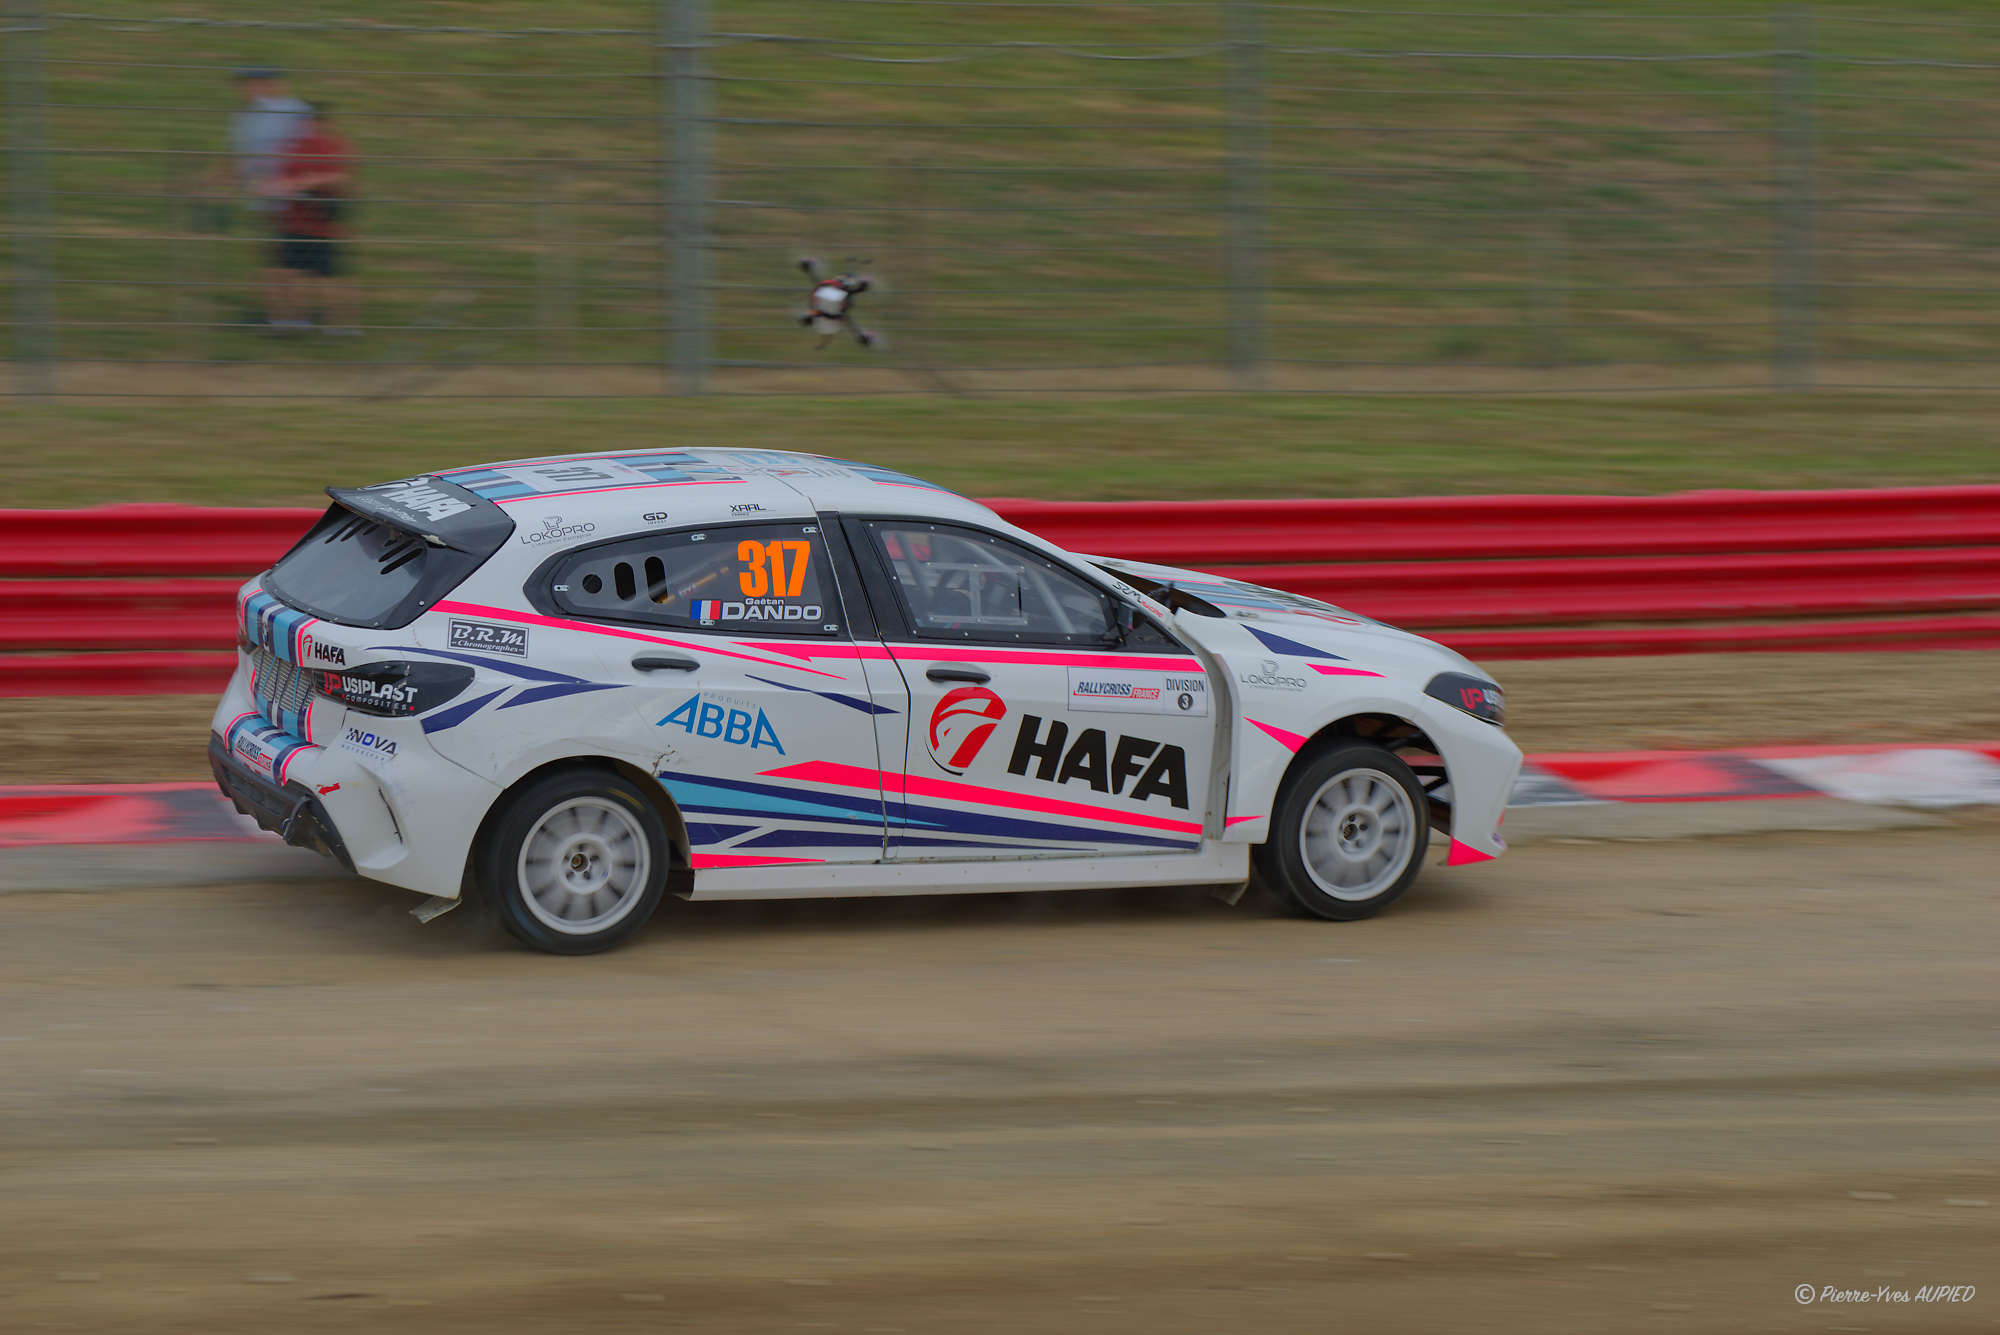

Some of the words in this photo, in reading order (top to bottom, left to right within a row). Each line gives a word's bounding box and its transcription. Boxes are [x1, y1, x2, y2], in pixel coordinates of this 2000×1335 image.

[642, 511, 668, 521] GD
[520, 522, 595, 545] LOKOPRO
[737, 540, 811, 597] 317
[745, 597, 785, 605] Gaëtan
[721, 602, 822, 621] DANDO
[314, 641, 346, 666] HAFA
[341, 676, 418, 703] USIPLAST
[1077, 681, 1132, 696] RALLYCROSS
[1166, 678, 1205, 692] DIVISION
[1240, 672, 1307, 688] LOKOPRO
[345, 694, 407, 711] COMPOSITES
[656, 692, 786, 756] ABBA
[1007, 714, 1189, 810] HAFA
